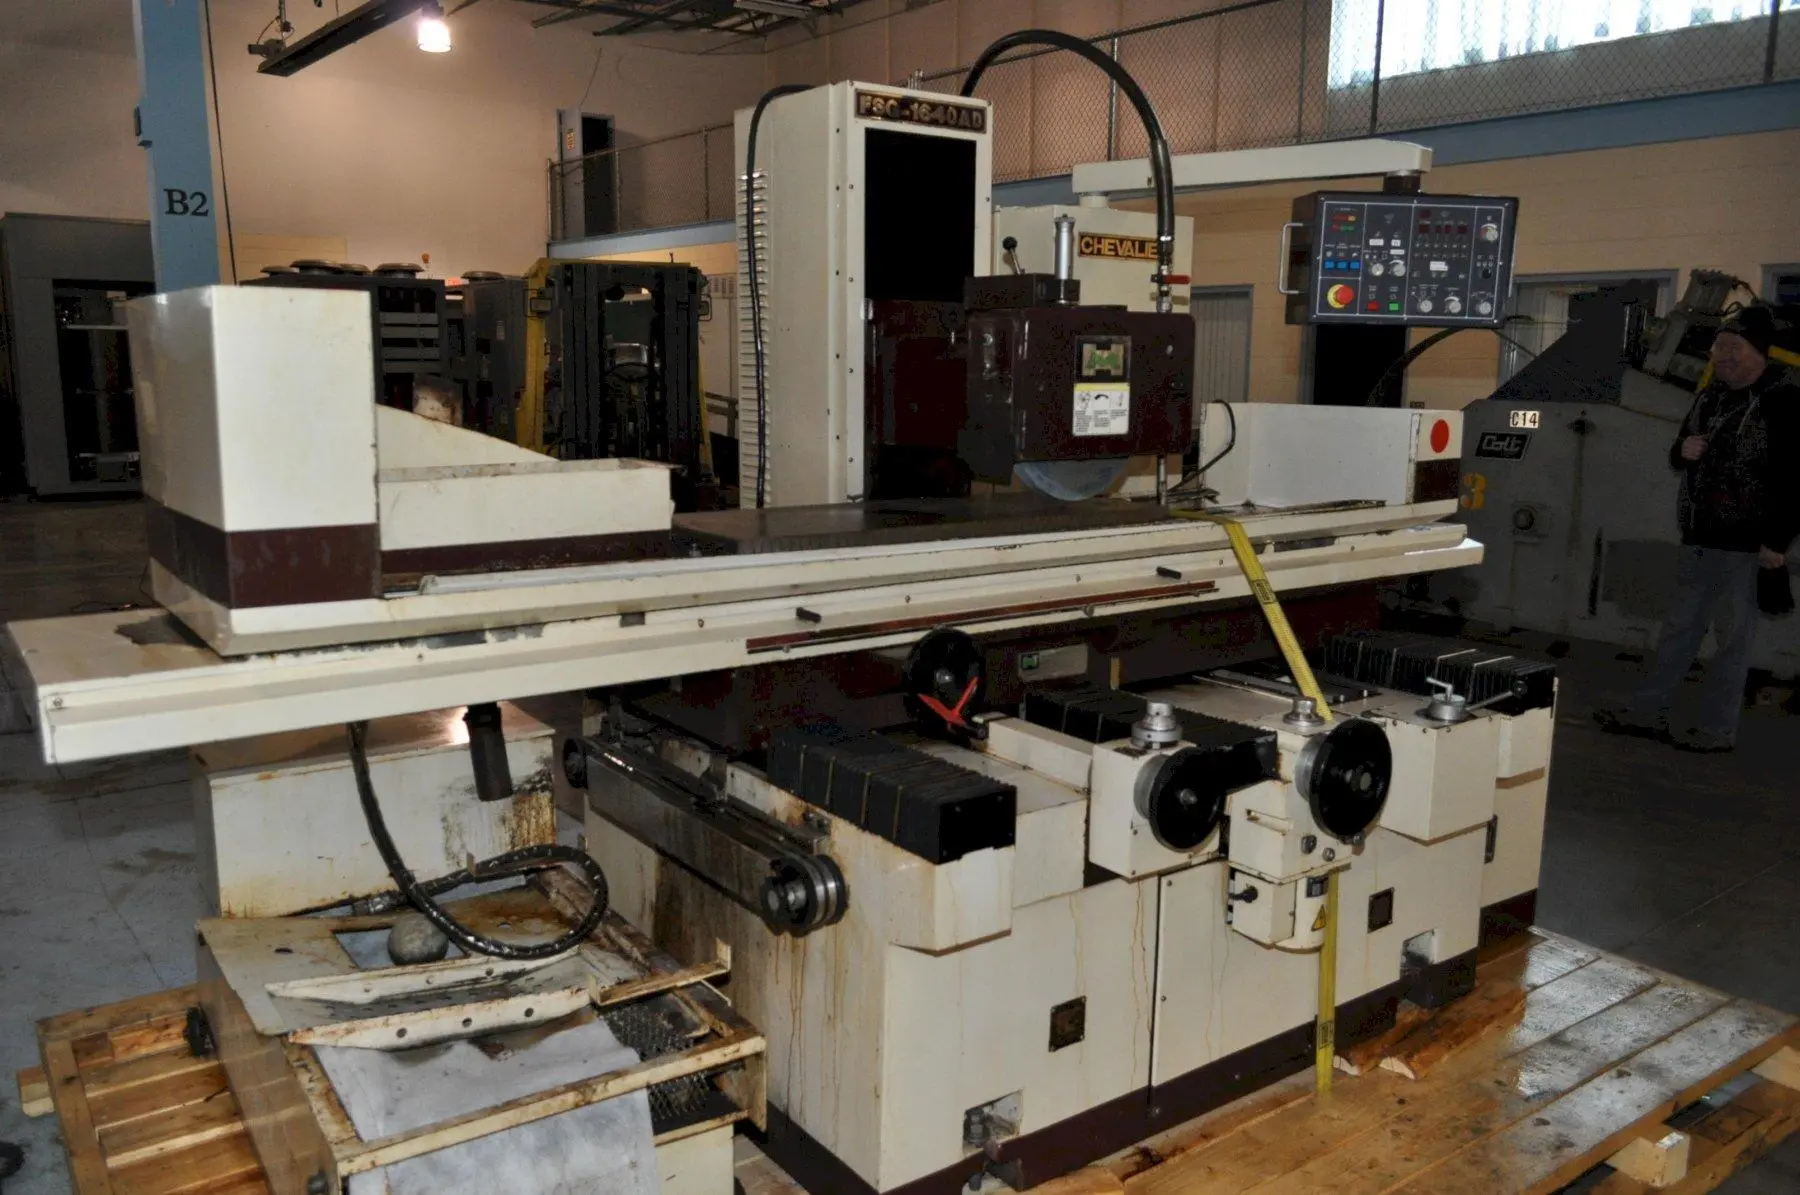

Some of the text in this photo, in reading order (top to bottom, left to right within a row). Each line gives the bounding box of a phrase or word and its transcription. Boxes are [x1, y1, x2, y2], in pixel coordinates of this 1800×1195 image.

[859, 95, 983, 129] FSG-1640AD
[163, 188, 209, 217] B2
[1081, 236, 1159, 259] CHEVALIE
[1512, 412, 1537, 427] C14
[1460, 472, 1487, 509] 3
